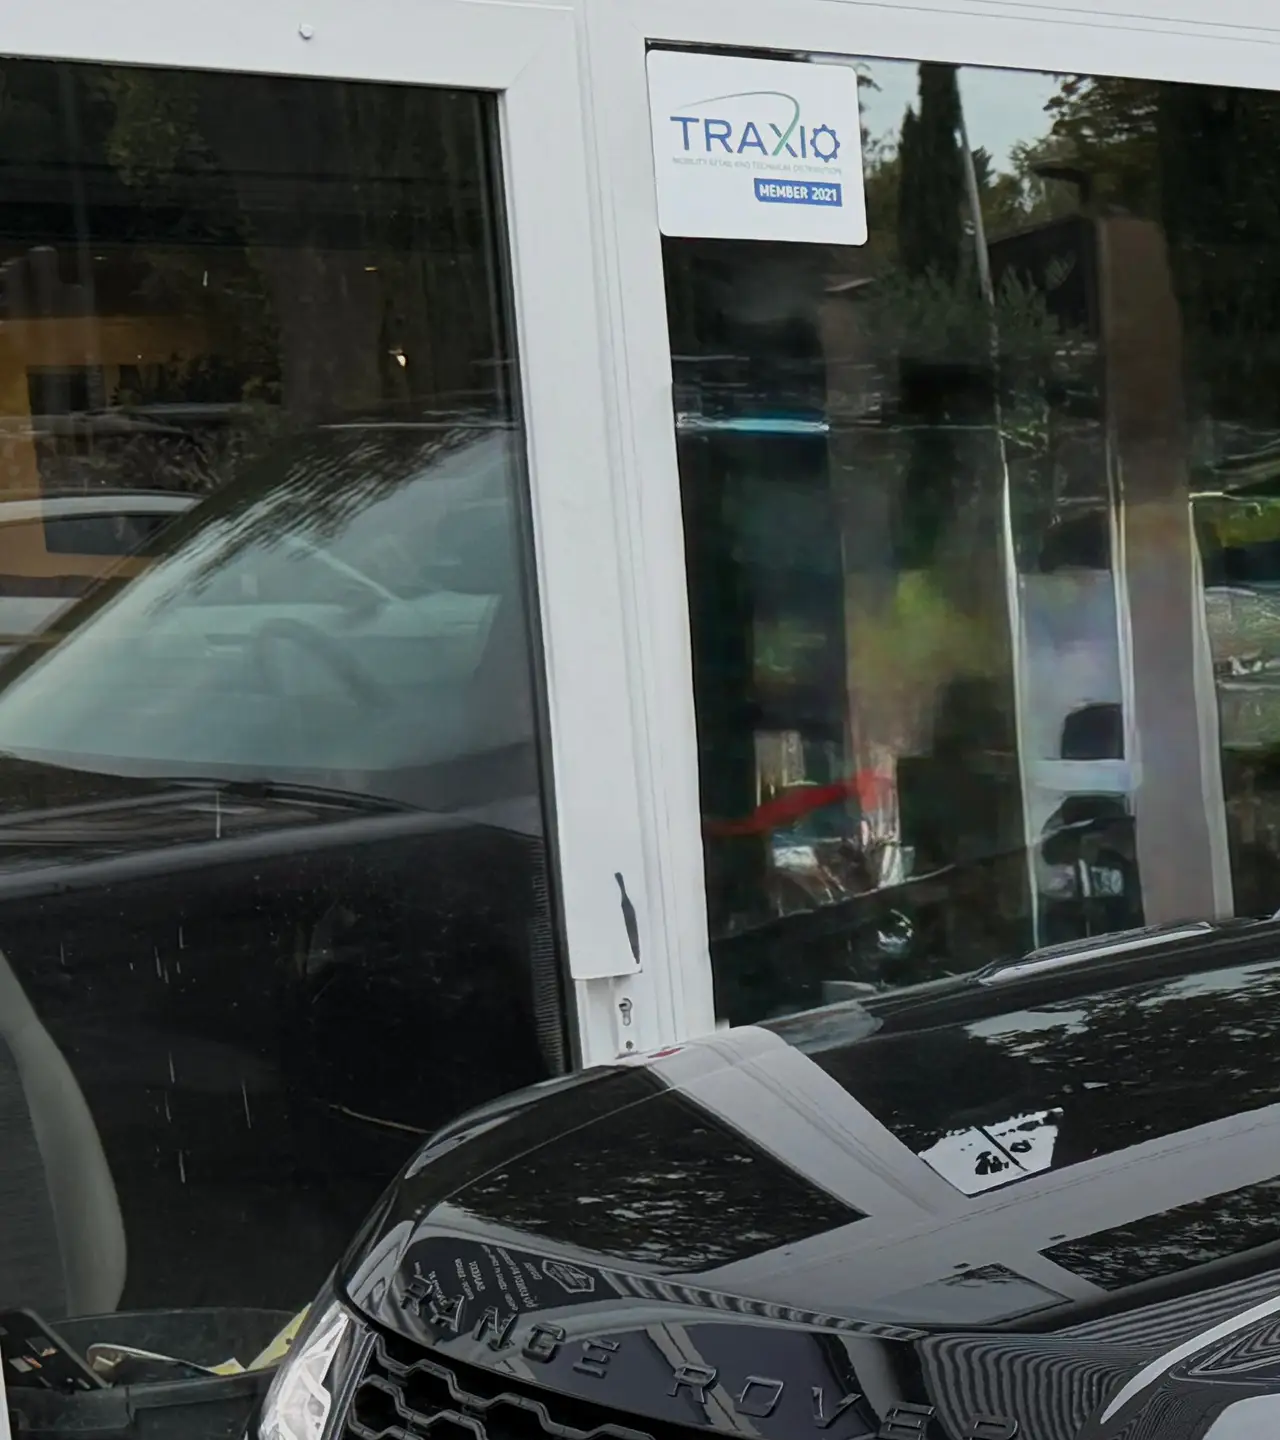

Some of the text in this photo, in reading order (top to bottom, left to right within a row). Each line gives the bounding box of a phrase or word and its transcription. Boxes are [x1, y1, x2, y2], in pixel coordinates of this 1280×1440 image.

[670, 116, 840, 163] TRAXIO
[759, 184, 837, 202] MEMBER 2021
[402, 1276, 620, 1378] RANGE
